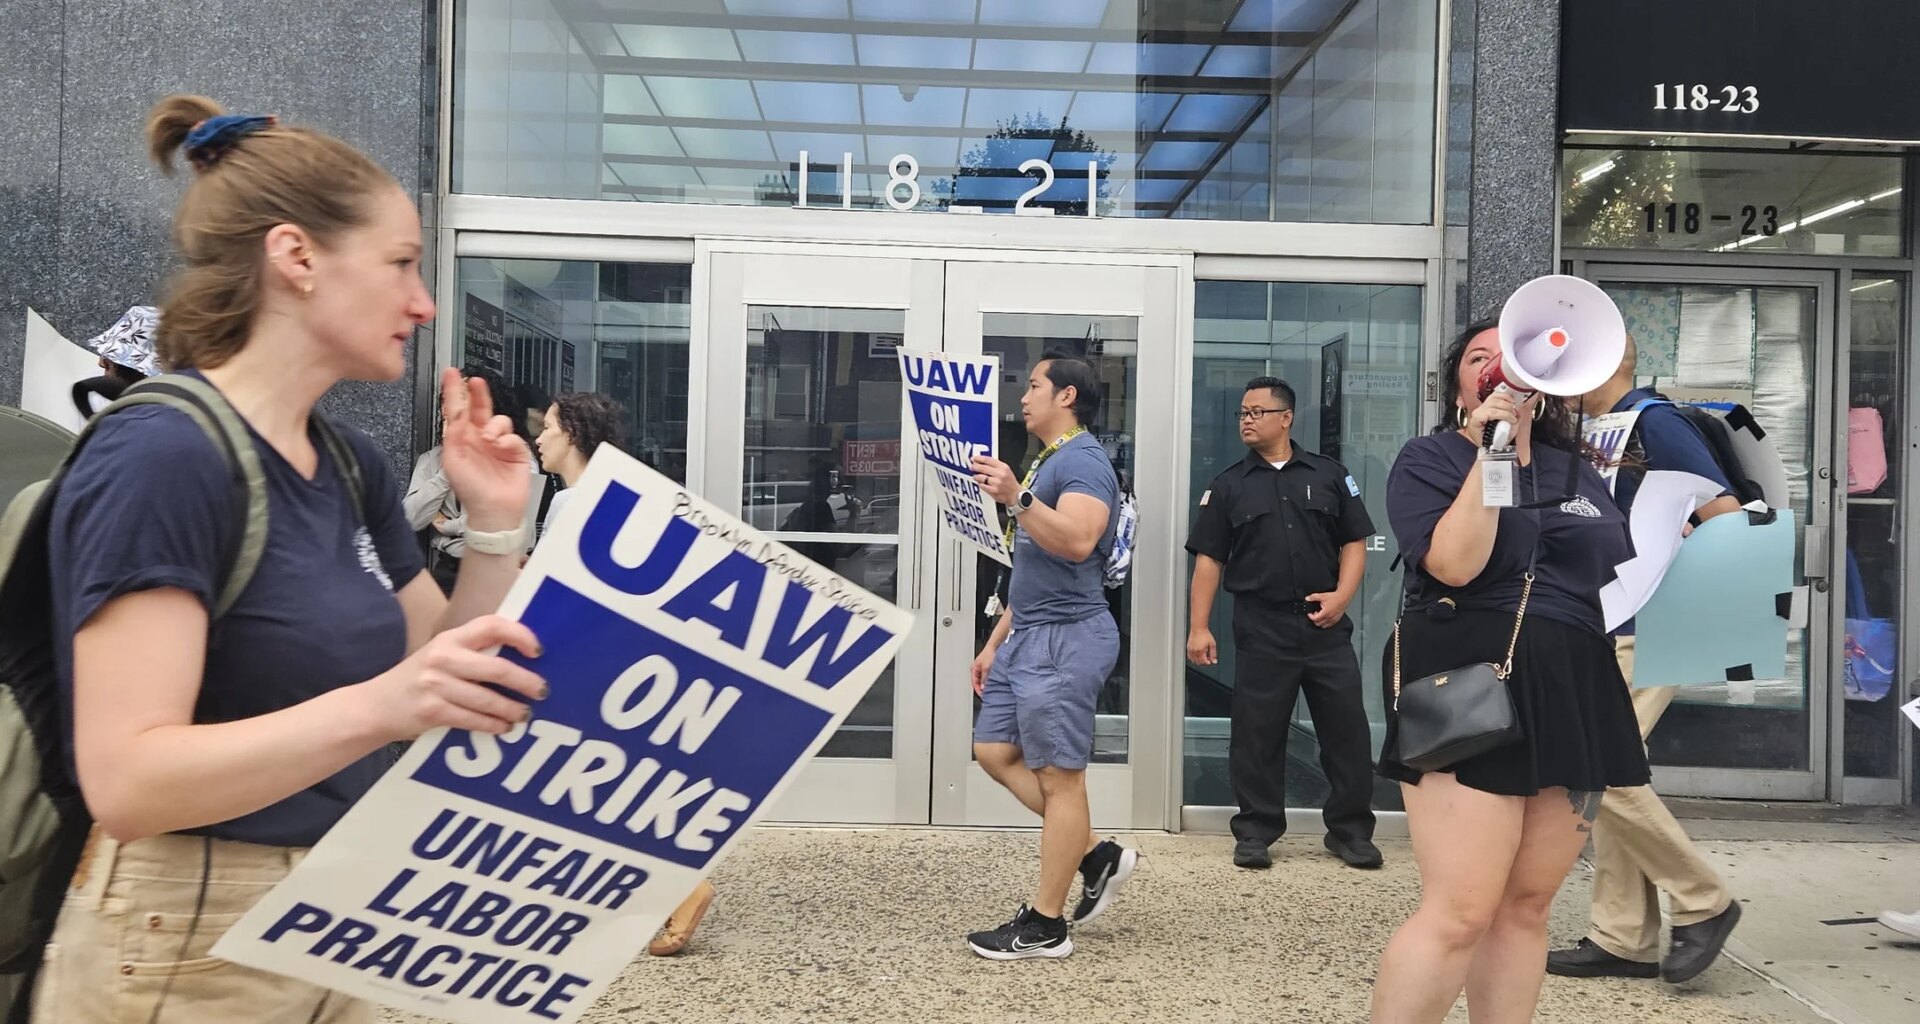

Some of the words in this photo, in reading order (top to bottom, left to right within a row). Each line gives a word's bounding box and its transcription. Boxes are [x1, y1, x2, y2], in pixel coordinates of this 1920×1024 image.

[1653, 83, 1760, 114] 118-23
[903, 355, 993, 395] UAW
[930, 401, 960, 434] ON
[936, 467, 983, 504] UNFAIR
[945, 491, 987, 527] LABOR
[944, 509, 1005, 555] PRACTICE
[578, 479, 897, 691] UAW
[600, 654, 743, 754] ON
[445, 719, 751, 852] STRIKE
[411, 808, 650, 910] UNFAIR
[366, 868, 591, 956] LABOR
[259, 901, 593, 1020] PRACTICE
